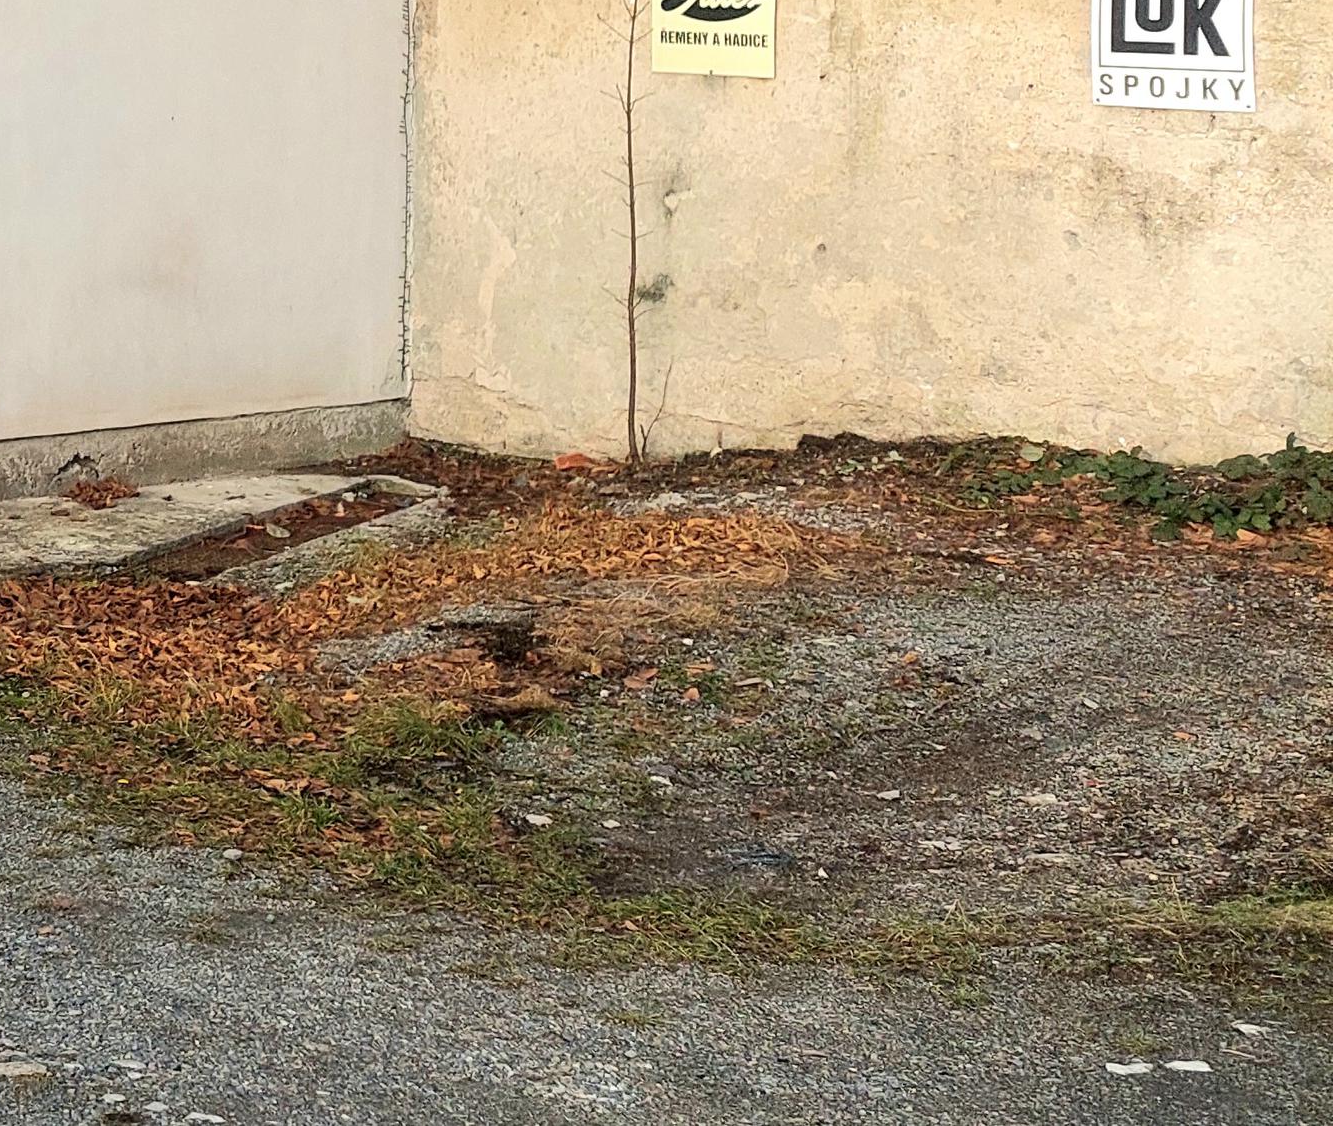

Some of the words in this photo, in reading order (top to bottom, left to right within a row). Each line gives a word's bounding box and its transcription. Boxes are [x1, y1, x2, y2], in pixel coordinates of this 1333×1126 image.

[713, 32, 720, 46] A
[724, 32, 769, 48] HADICE
[1099, 73, 1245, 101] SPOJKY
